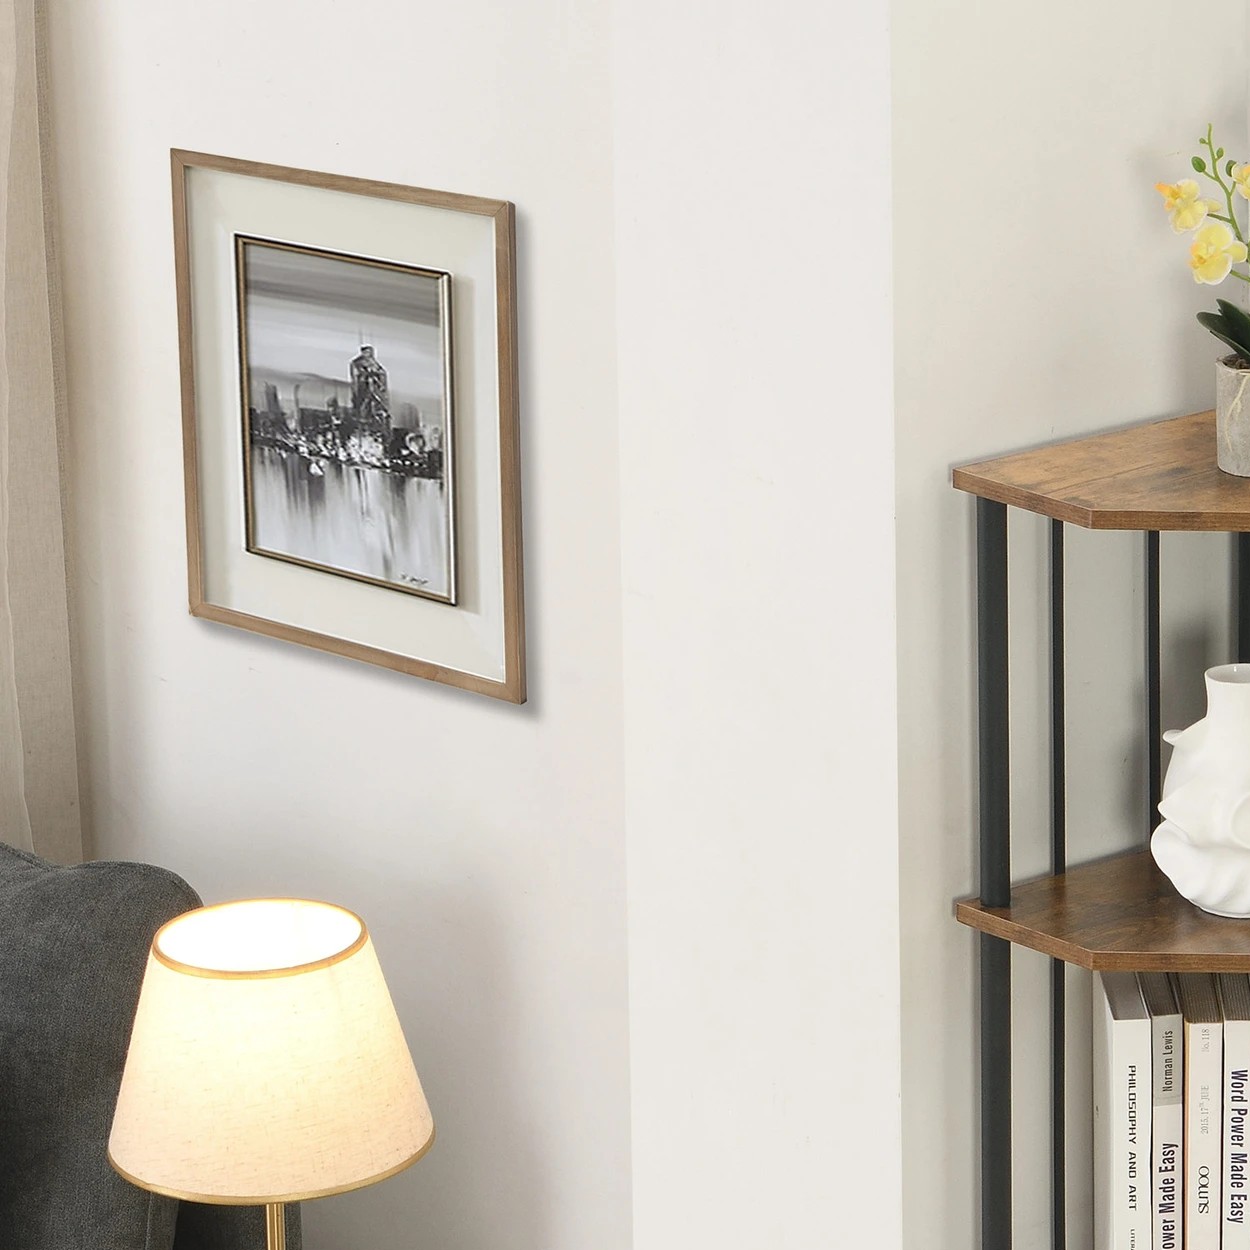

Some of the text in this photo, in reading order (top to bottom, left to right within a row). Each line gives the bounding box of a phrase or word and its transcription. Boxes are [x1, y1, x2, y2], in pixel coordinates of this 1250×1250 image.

[1162, 1030, 1173, 1092] Norman Lewis
[1128, 1065, 1137, 1211] PHILOSOPHY AND ART
[1159, 1143, 1179, 1173] Easy
[1226, 1069, 1249, 1224] Word Power Made Easy
[1159, 1178, 1176, 1214] Made
